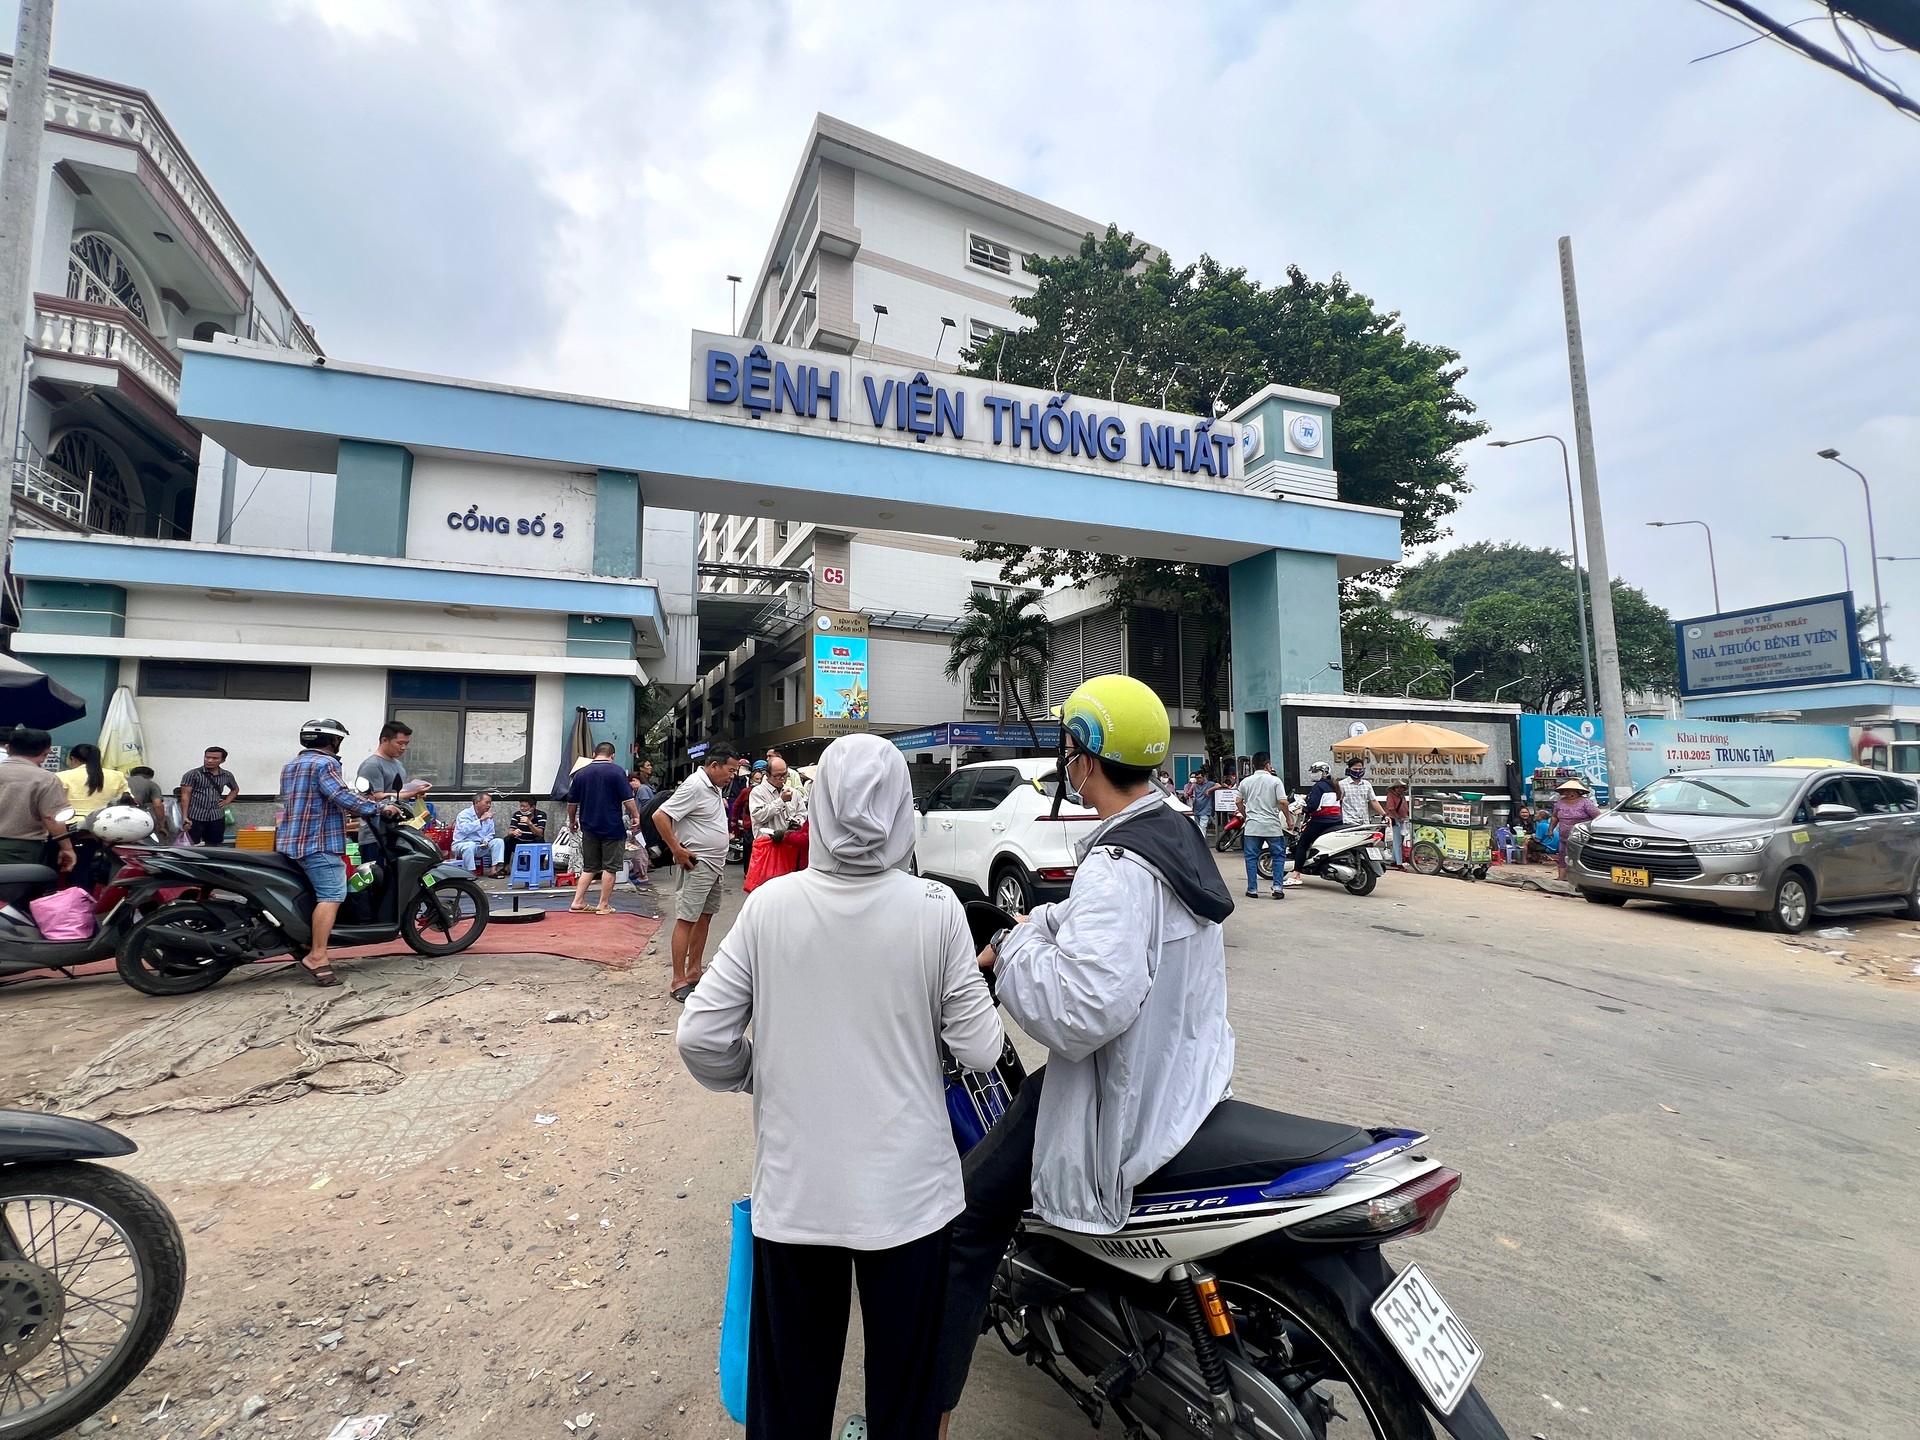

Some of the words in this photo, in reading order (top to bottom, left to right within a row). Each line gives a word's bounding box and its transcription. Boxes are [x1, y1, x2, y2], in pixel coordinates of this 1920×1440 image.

[706, 346, 840, 420] BỆNH
[863, 372, 966, 443] VIỆN
[984, 392, 1127, 463] THỐNG
[1140, 417, 1236, 479] NHẤT
[1301, 427, 1315, 438] TN
[447, 504, 510, 534] CỔNG
[517, 513, 546, 536] SỐ
[553, 522, 565, 538] 2
[824, 568, 844, 584] C5
[1784, 617, 1808, 628] NHẤT
[1692, 644, 1717, 659] NHÀ
[1719, 637, 1761, 656] THUỐC
[1677, 733, 1697, 743] Khai
[1700, 734, 1729, 746] trương
[1144, 742, 1166, 755] ACB
[1667, 750, 1711, 760] 17.10.2025
[1715, 748, 1750, 762] TRUNG
[1752, 746, 1775, 762] TÂM
[1621, 869, 1638, 877] 51H
[1092, 1238, 1172, 1259] YAMAHA
